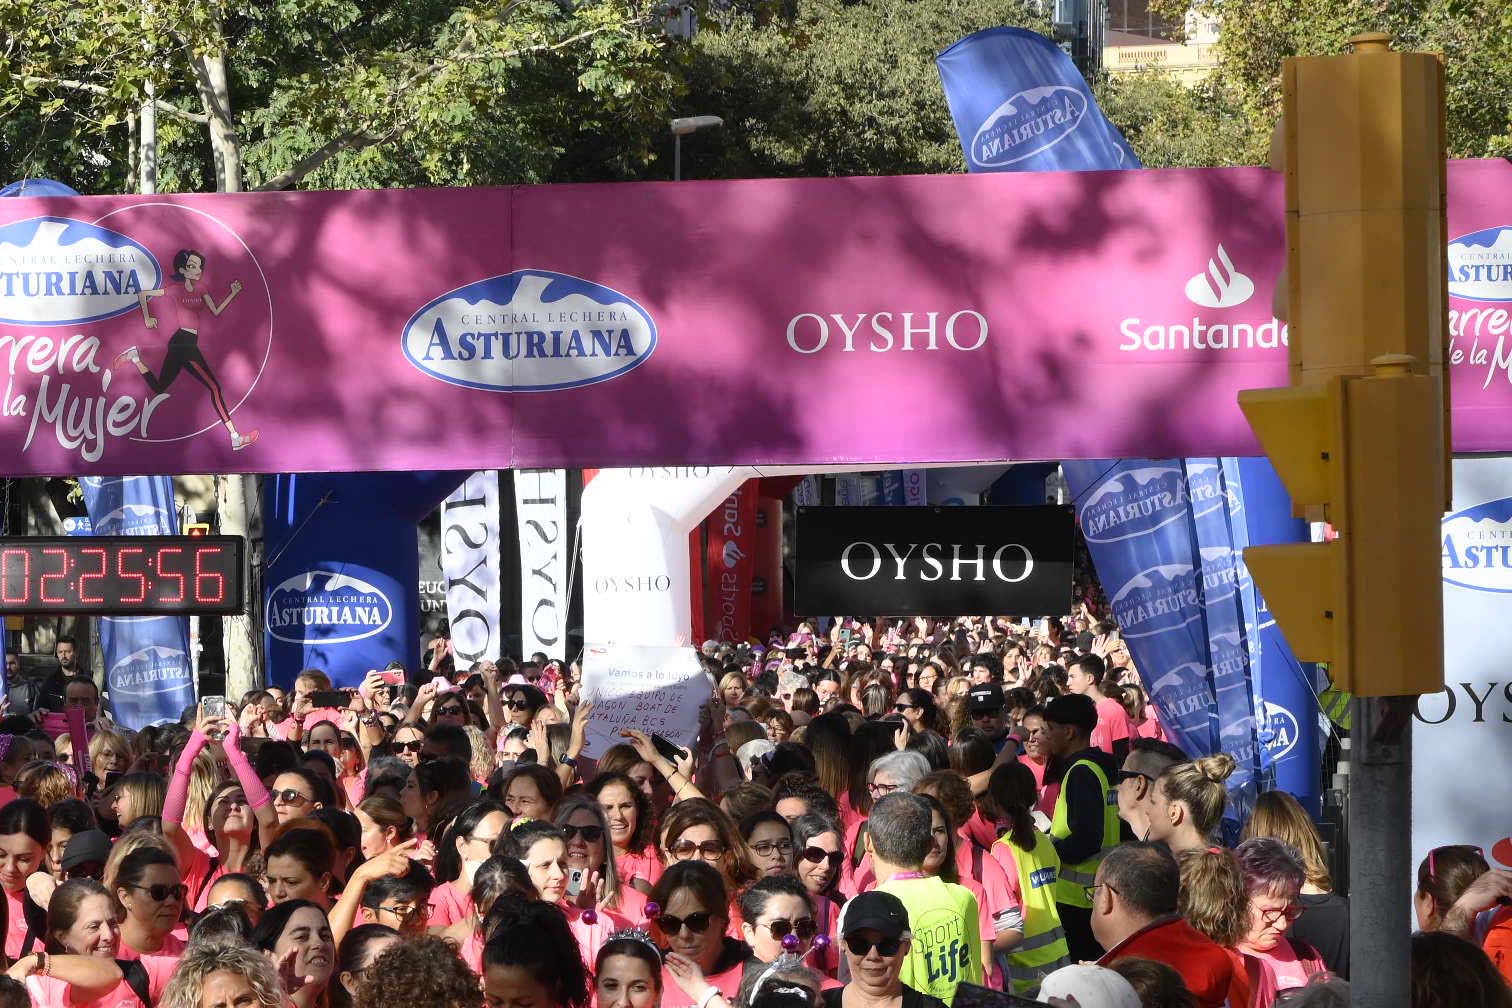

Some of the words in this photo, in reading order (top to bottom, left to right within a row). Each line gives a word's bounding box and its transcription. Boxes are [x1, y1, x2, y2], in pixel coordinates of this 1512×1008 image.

[65, 252, 137, 264] LECHERA
[461, 313, 540, 325] CENTRAL
[547, 311, 630, 323] LECHERA
[786, 310, 989, 354] OYSHO
[1119, 317, 1289, 351] Santande
[422, 317, 638, 361] ASTURIANA
[1469, 337, 1488, 365] la
[2, 380, 26, 417] la
[22, 370, 171, 463] Mujer
[1, 548, 224, 602] 02:25:56
[840, 541, 1035, 582] OYSHO
[281, 595, 325, 604] CENTRAL
[329, 595, 379, 604] LECHERA
[594, 575, 671, 593] OYSHO
[270, 600, 384, 628] ASTURIANA
[914, 915, 962, 954] Sport
[924, 938, 970, 984] Life
